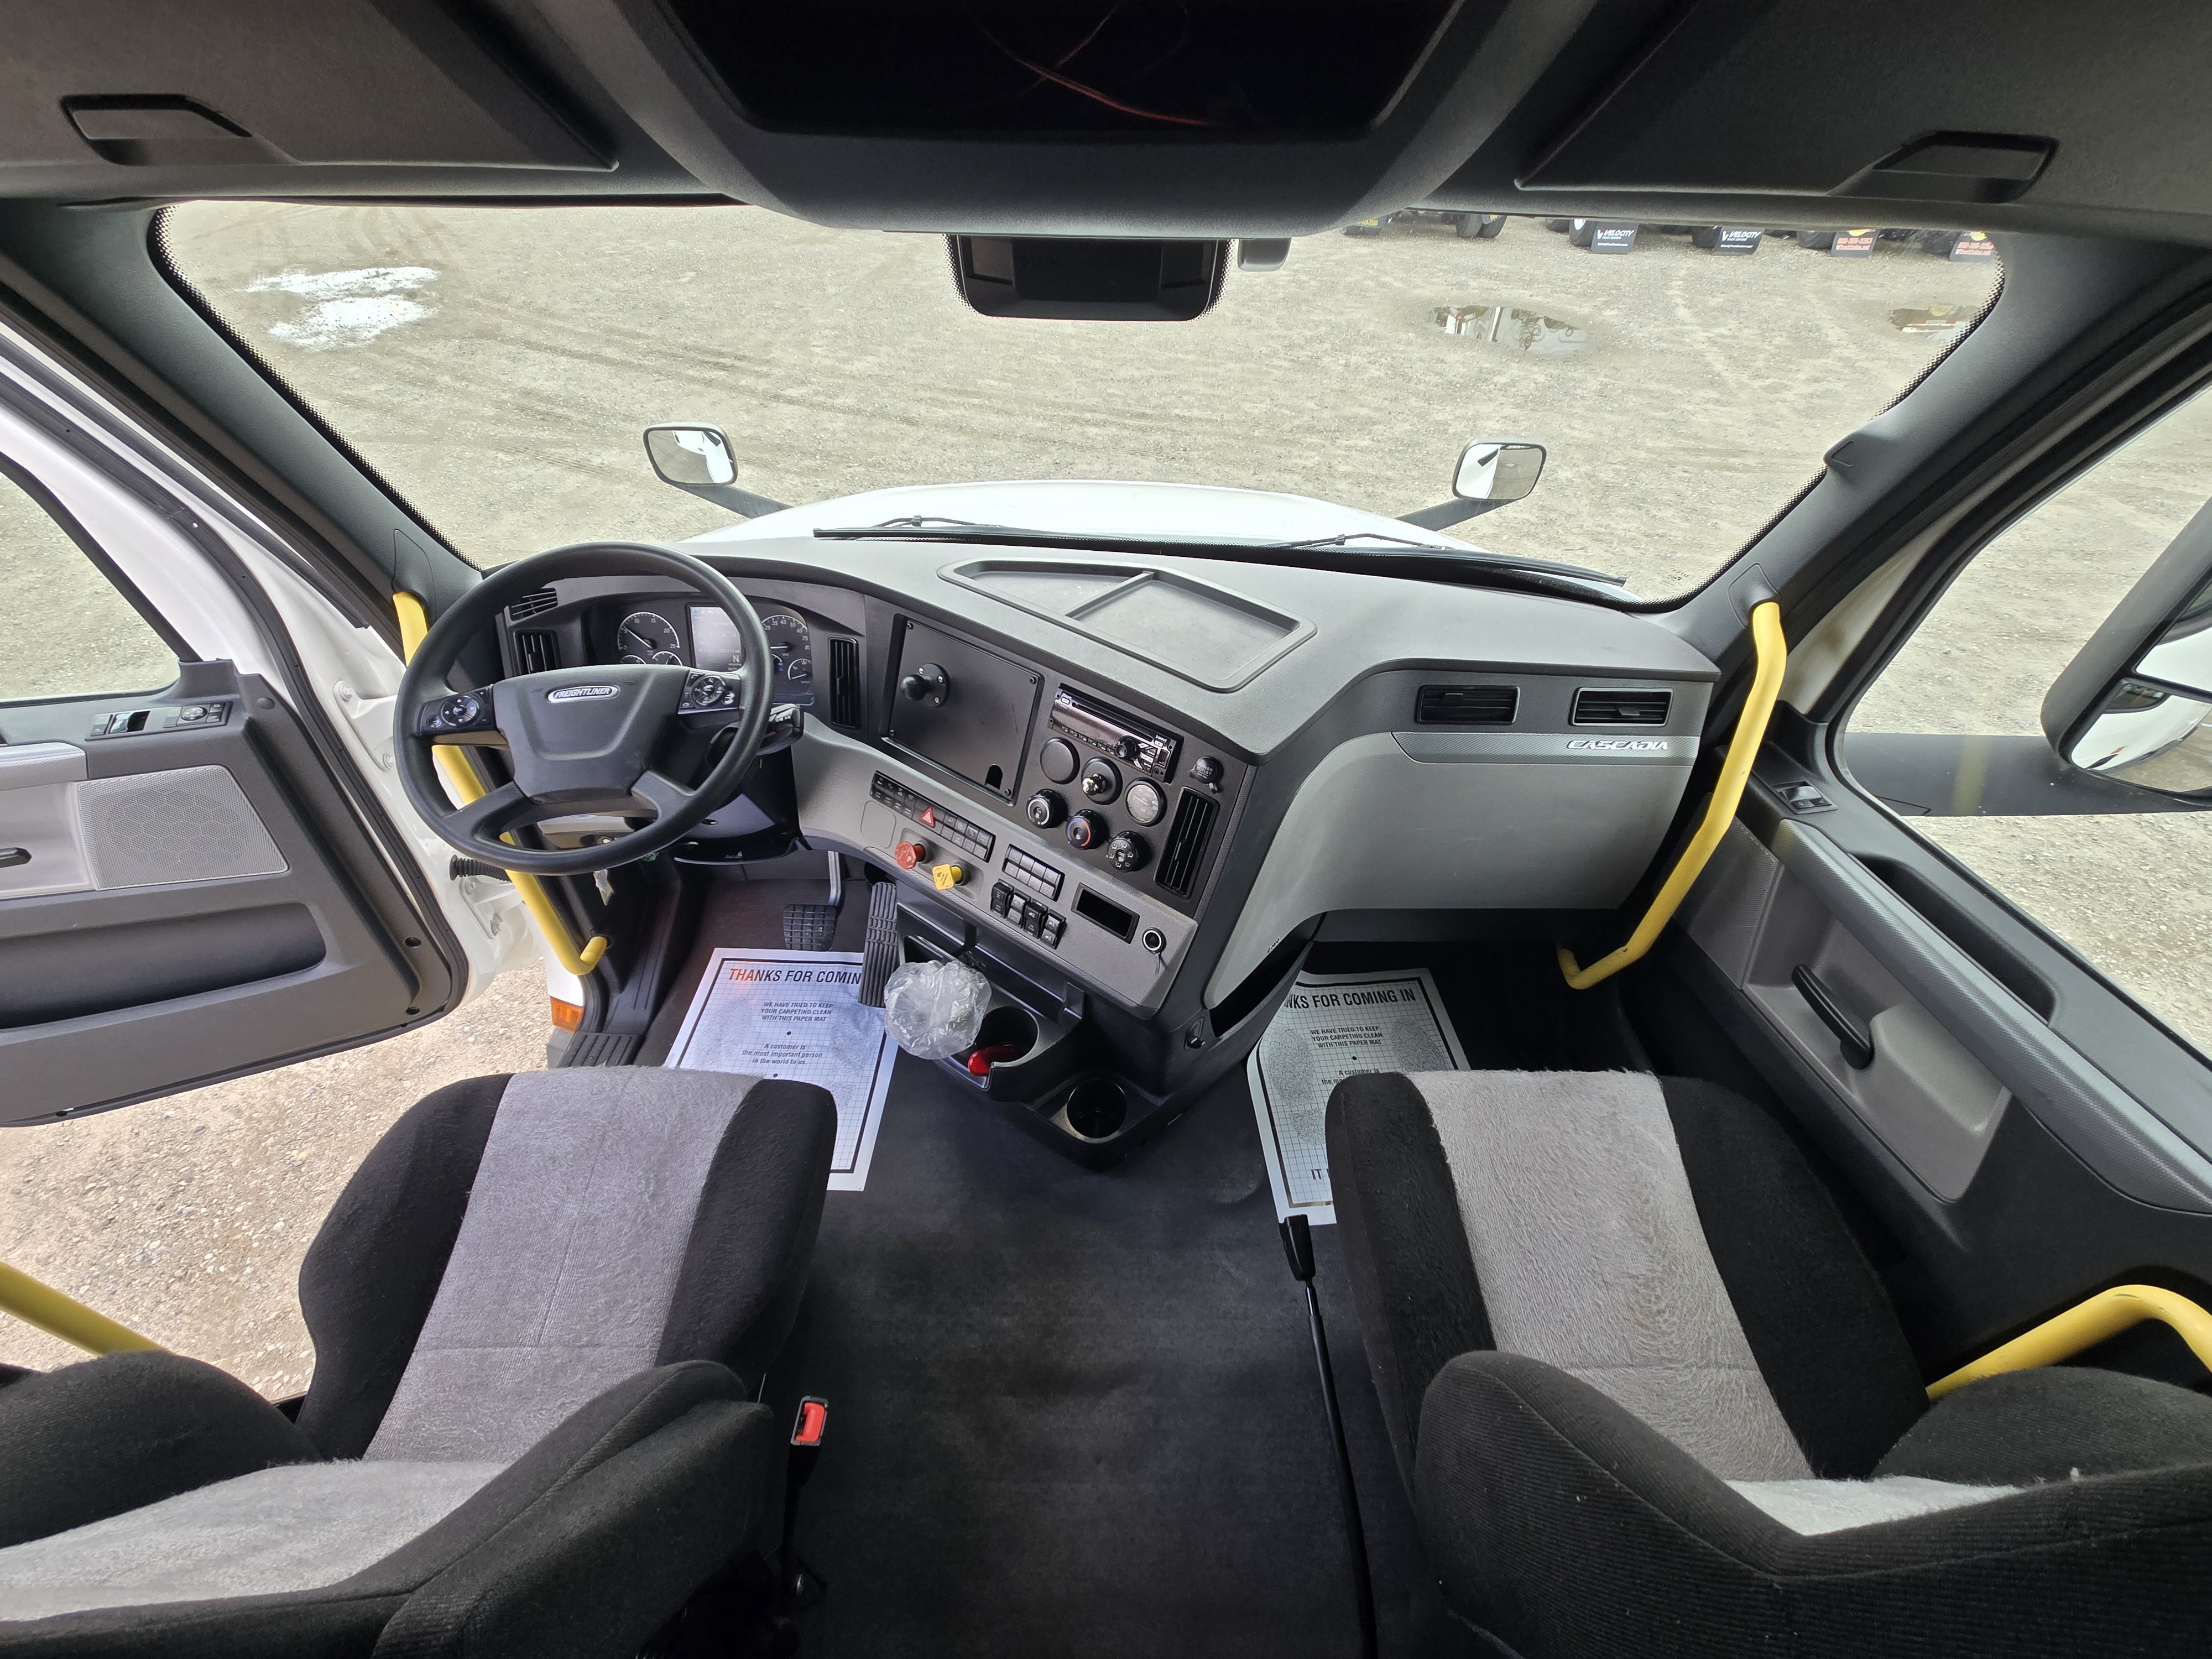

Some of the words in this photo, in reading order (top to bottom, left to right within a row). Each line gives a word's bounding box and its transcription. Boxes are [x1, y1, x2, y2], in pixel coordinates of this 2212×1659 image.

[555, 688, 611, 698] FREIGHTLINER
[1567, 740, 1668, 750] CASCADIA
[729, 968, 782, 982] THANKS
[784, 970, 813, 983] FOR
[816, 971, 862, 985] COMIN
[1286, 994, 1310, 1009] NKS
[1312, 993, 1341, 1008] FOR
[1344, 990, 1398, 1006] COMING
[1399, 988, 1416, 1001] IN
[1311, 1168, 1322, 1180] IT
